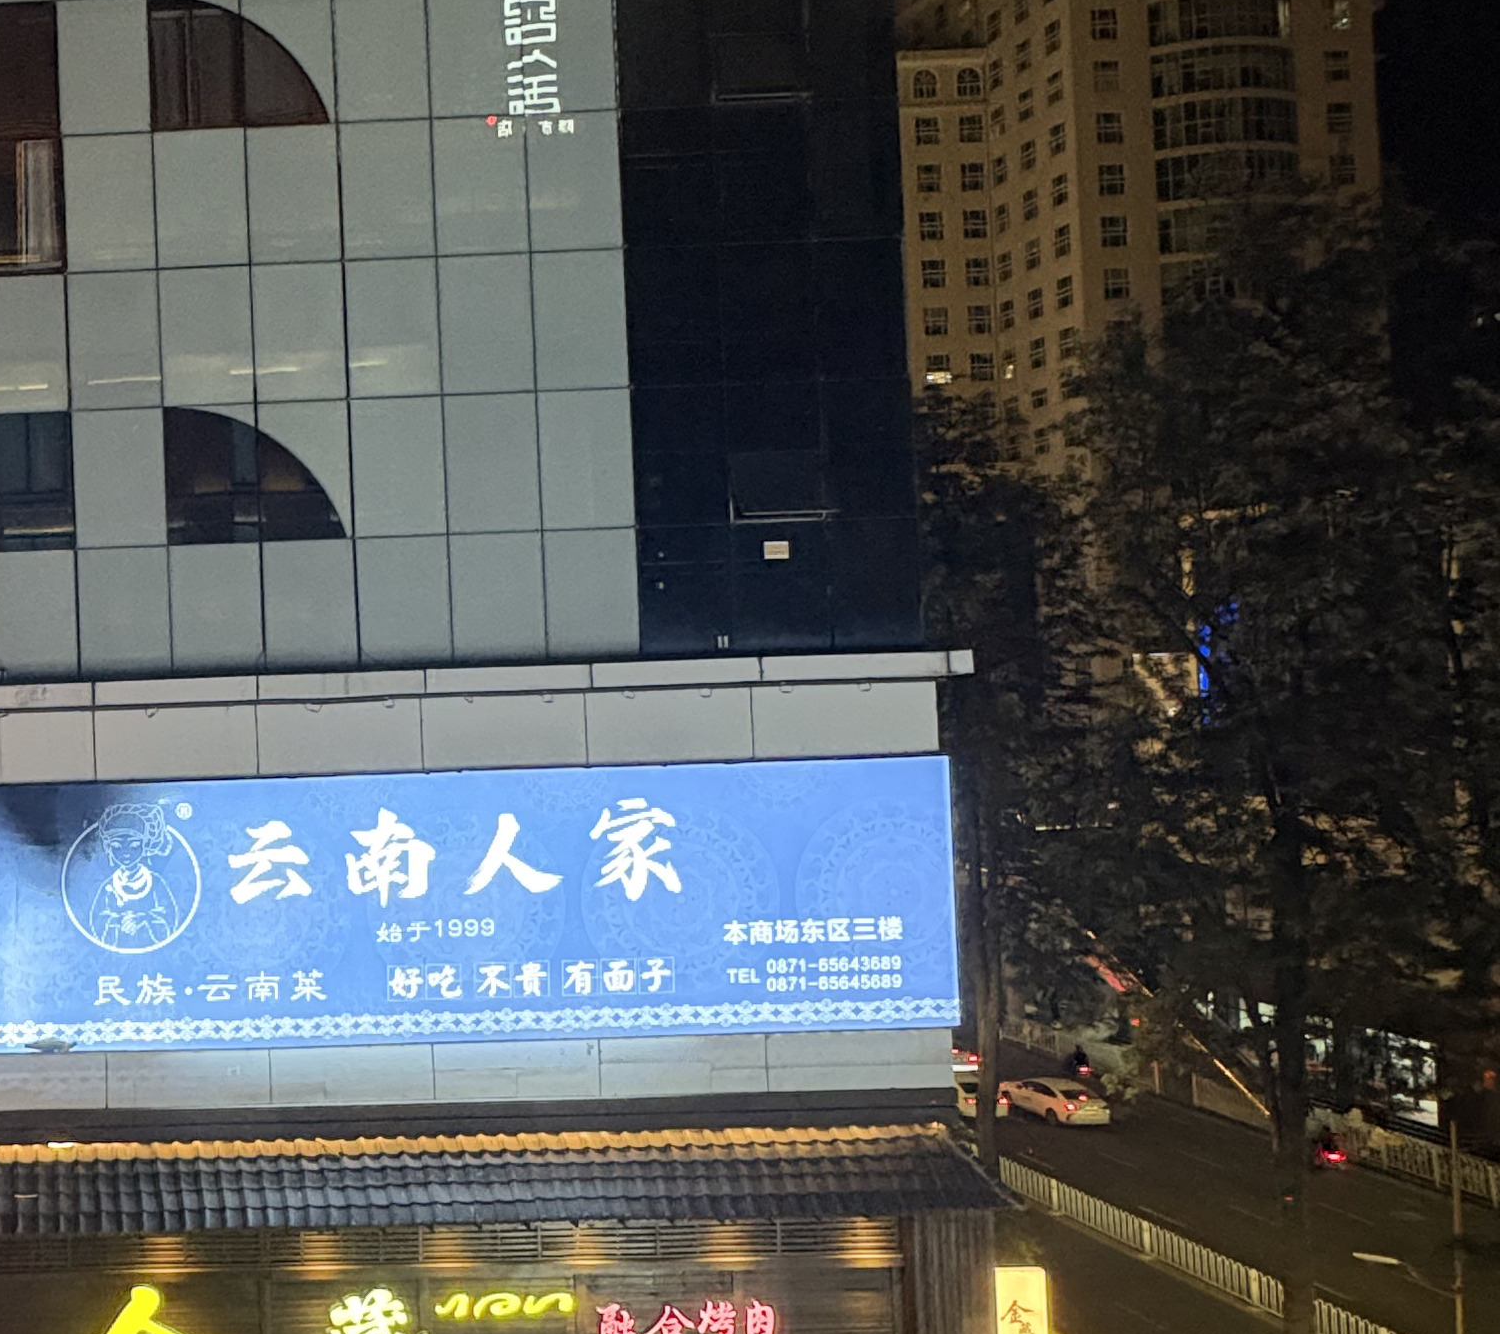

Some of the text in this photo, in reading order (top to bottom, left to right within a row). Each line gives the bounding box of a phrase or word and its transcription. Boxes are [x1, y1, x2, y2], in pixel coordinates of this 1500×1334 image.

[228, 796, 682, 907] 云南人家
[376, 917, 496, 944] 始于1999
[723, 915, 904, 946] 本商场东区三楼
[726, 967, 761, 985] TEL
